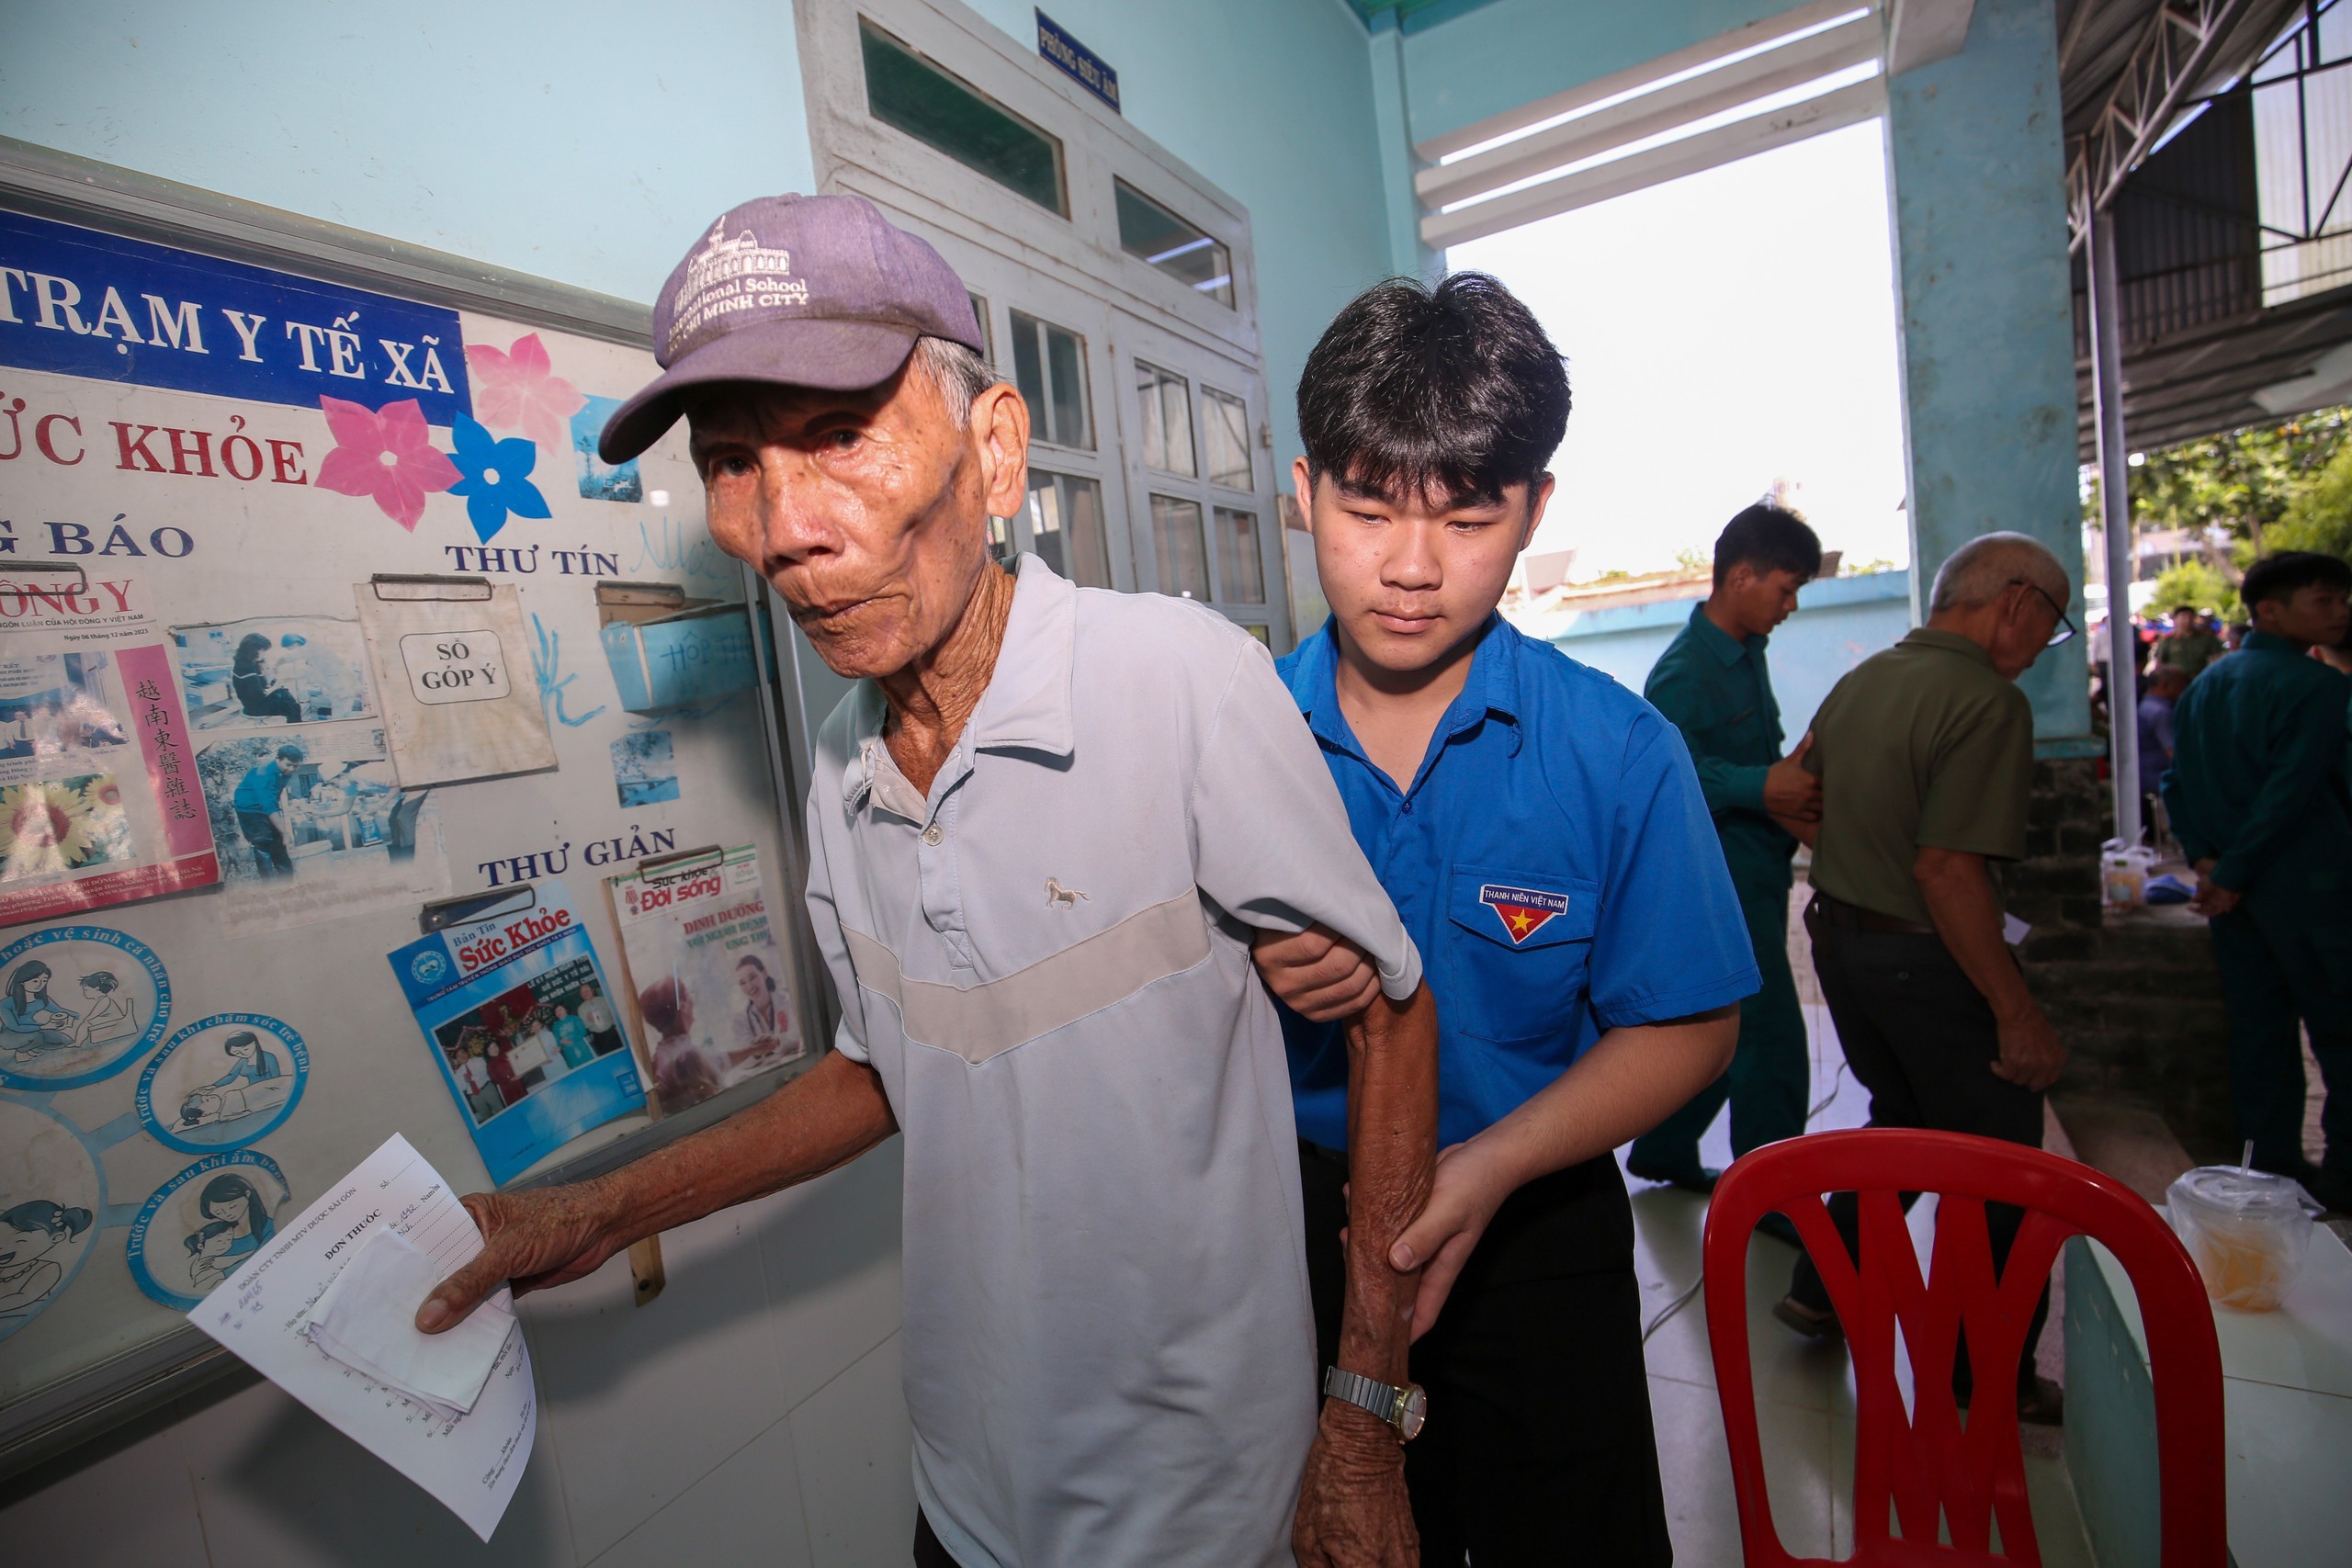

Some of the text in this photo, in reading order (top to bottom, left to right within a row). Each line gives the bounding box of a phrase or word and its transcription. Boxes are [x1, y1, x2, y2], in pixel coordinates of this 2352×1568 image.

[746, 277, 808, 293] School
[704, 294, 753, 320] MINH
[759, 293, 809, 307] CITY
[0, 265, 454, 394] TRẠM Y TẾ XÃ
[108, 415, 307, 485] KHỎE
[43, 513, 194, 558] BÁO
[445, 544, 539, 574] THƯ
[551, 544, 618, 576] TÍN
[96, 580, 134, 613] Y
[91, 631, 109, 640] tháng
[422, 662, 496, 690] GÓP Ý
[479, 824, 675, 888] THƯ GIẢN
[640, 887, 671, 911] Đời
[676, 875, 721, 902] sống
[1485, 889, 1565, 908] THANH NIÊN VIỆT NAM
[52, 928, 74, 941] vệ
[82, 929, 120, 944] sinh
[453, 932, 476, 946] Bản
[458, 908, 571, 972] Sức Khỏe
[683, 919, 717, 935] DINH
[125, 941, 148, 955] cá
[143, 955, 169, 989] nhân
[159, 993, 172, 1019] cho
[146, 1022, 167, 1044] trẻ
[136, 1013, 310, 1127] Trước và sau khi chăm sóc trẻ bệnh
[128, 1215, 149, 1260] Trước
[147, 1193, 166, 1210] và
[168, 1169, 196, 1190] sau
[199, 1155, 226, 1171] khi
[258, 1258, 274, 1273] CTY
[272, 1240, 293, 1260] TNHH
[290, 1226, 308, 1244] MTV
[327, 1199, 342, 1213] SÀI
[341, 1187, 357, 1202] GÒN
[324, 1208, 382, 1260] ĐƠN THUỐC
